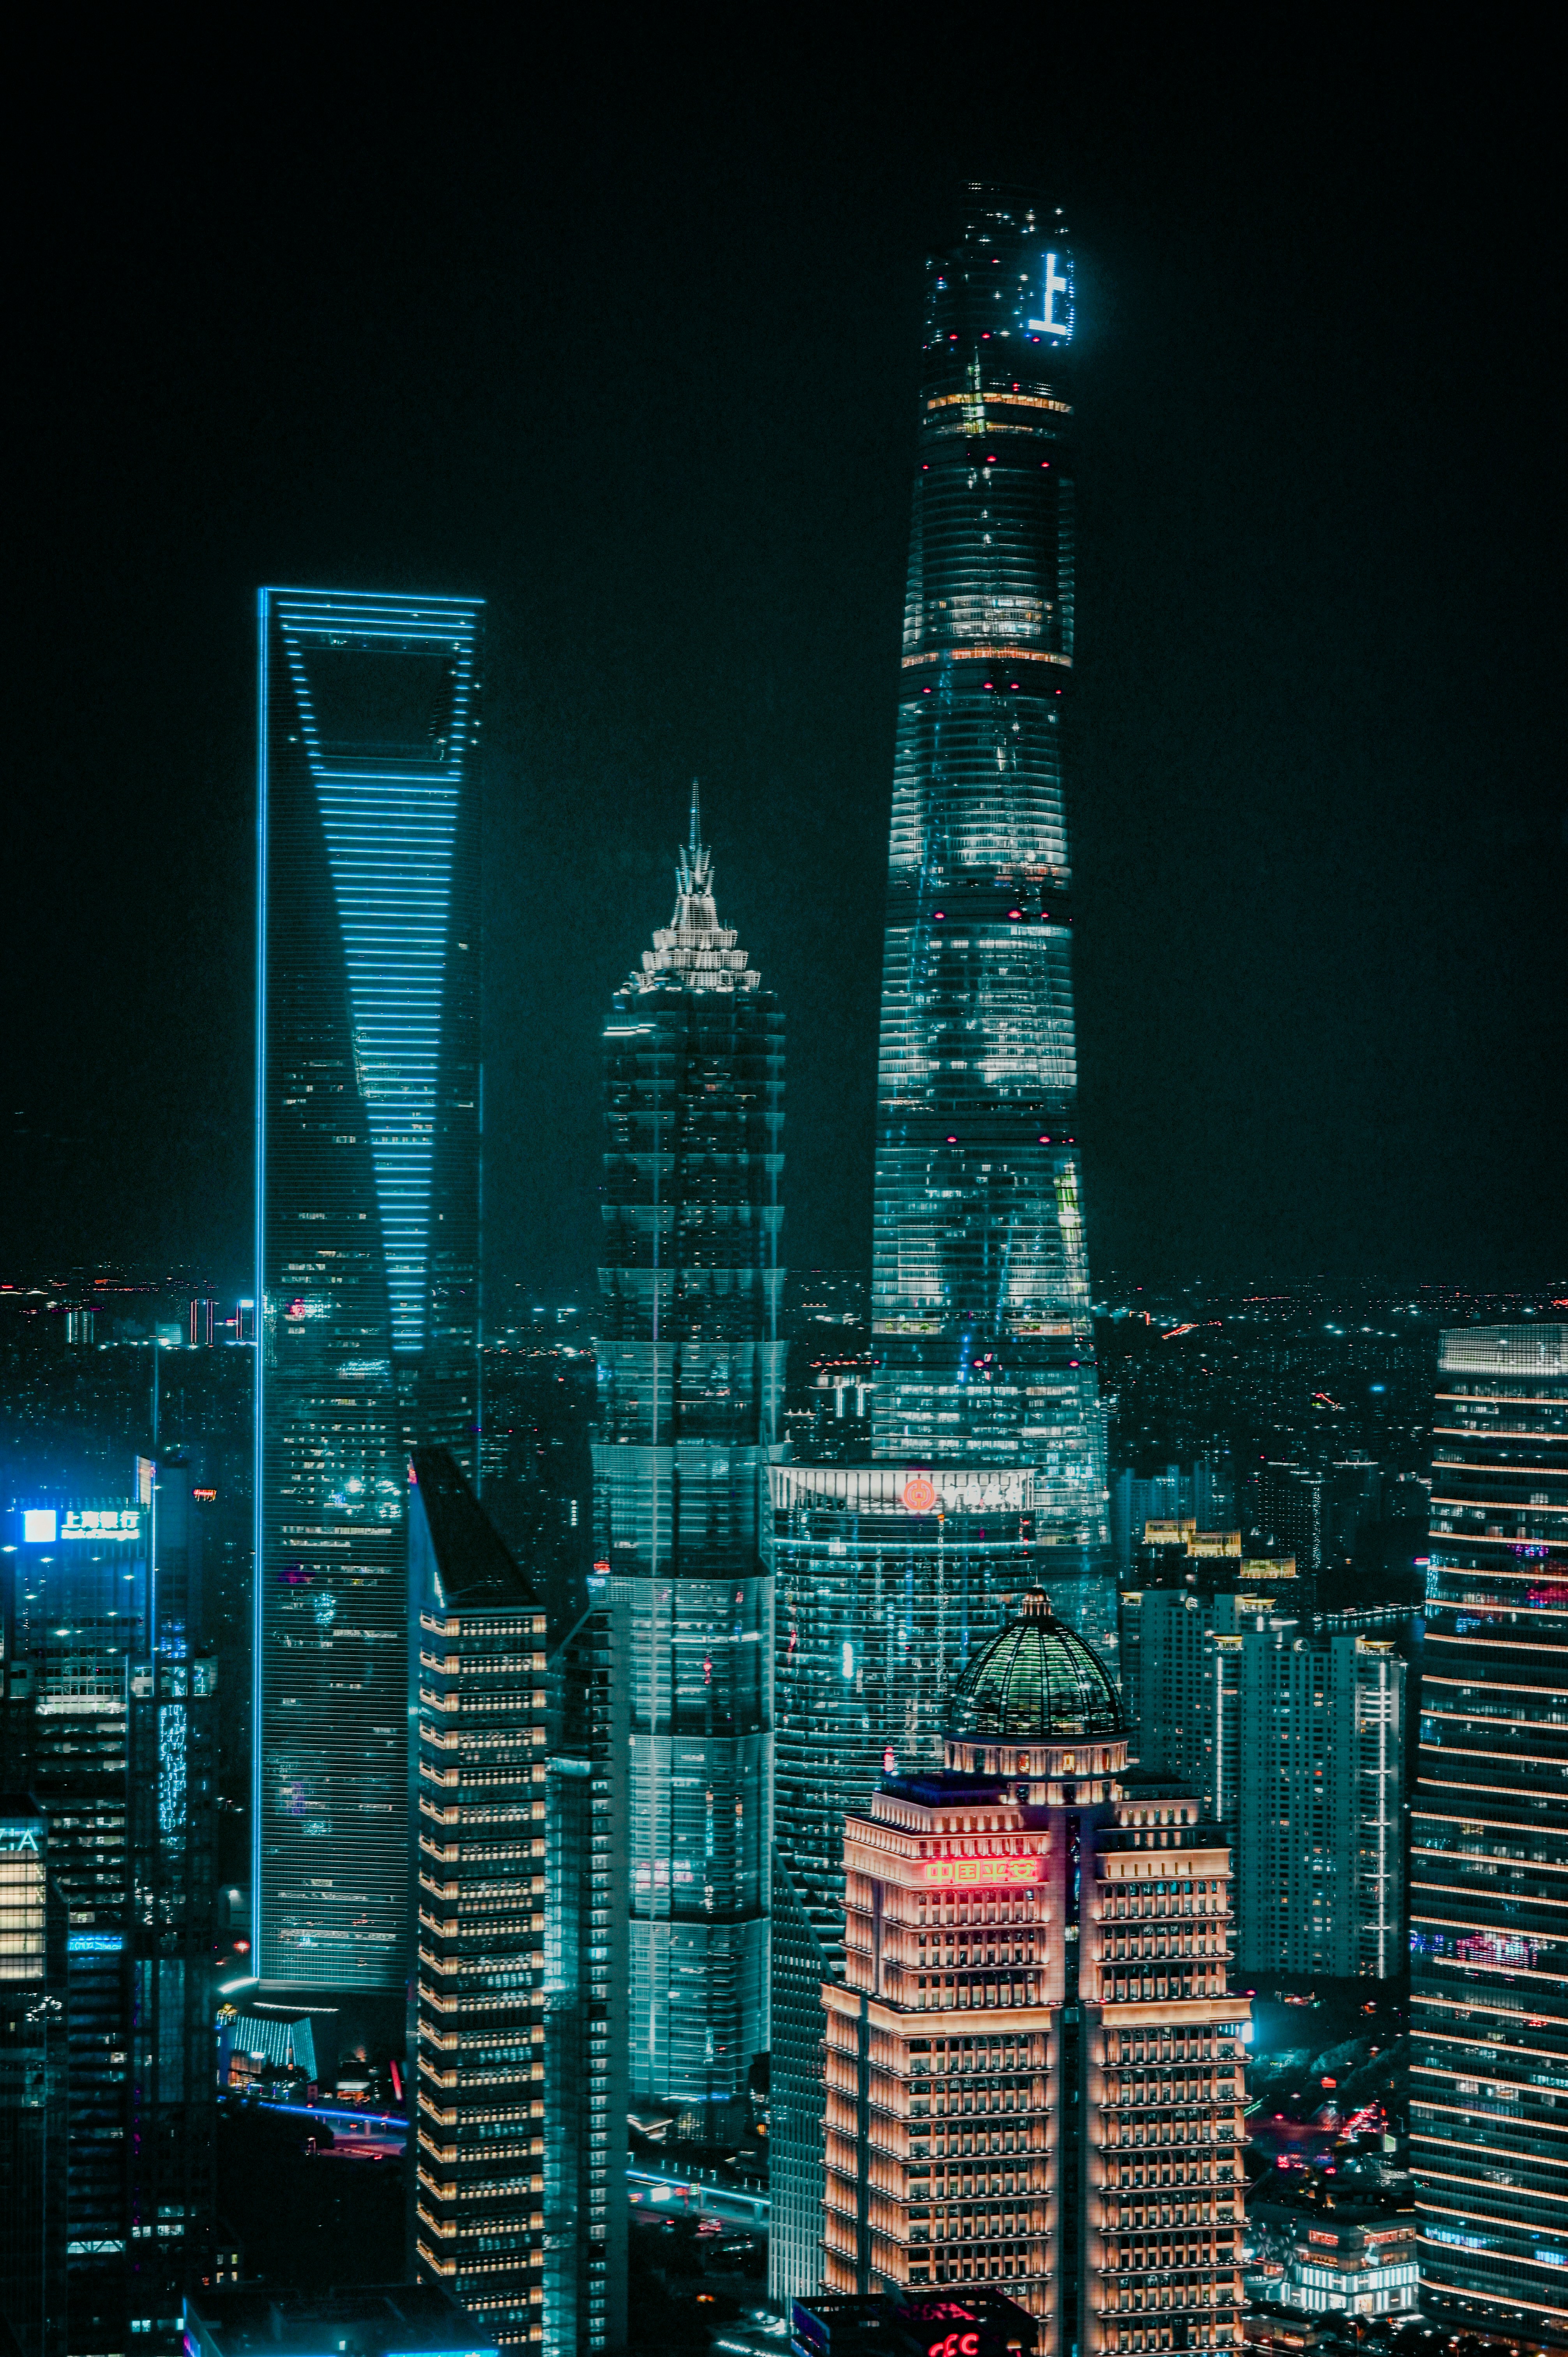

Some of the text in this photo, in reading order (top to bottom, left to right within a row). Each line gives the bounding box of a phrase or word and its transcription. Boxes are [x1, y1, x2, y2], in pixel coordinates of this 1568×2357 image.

[1028, 253, 1067, 335] 上
[927, 1859, 1035, 1883] 中国平安
